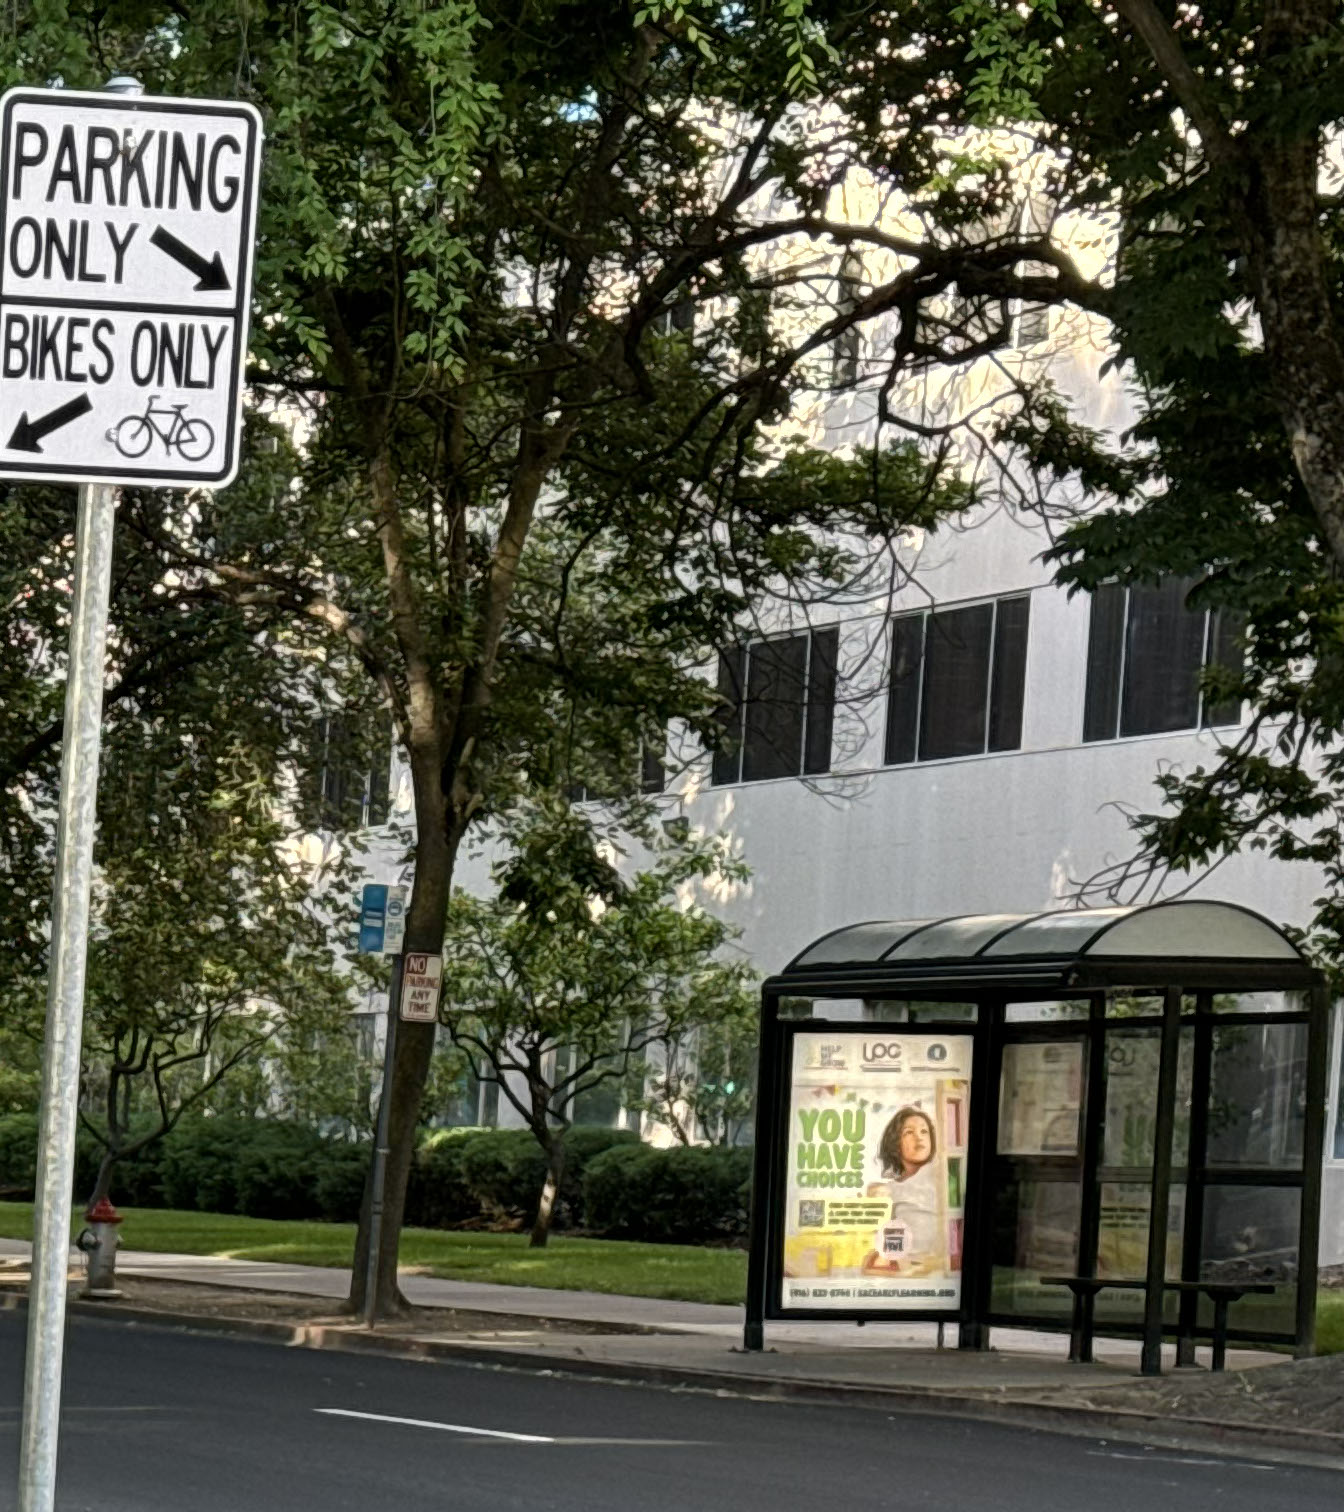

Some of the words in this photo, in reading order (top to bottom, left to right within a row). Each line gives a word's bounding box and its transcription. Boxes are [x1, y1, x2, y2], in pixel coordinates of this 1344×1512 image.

[11, 120, 242, 213] PARKING
[9, 216, 140, 284] ONLY
[2, 313, 115, 385] BIKES
[130, 320, 230, 390] ONLY
[408, 956, 426, 973] NO
[405, 975, 441, 988] PARKING
[410, 989, 431, 1001] ANY
[408, 1001, 431, 1013] TIME
[797, 1108, 866, 1143] YOU
[797, 1142, 866, 1169] HAVE
[796, 1170, 864, 1188] CHOICES
